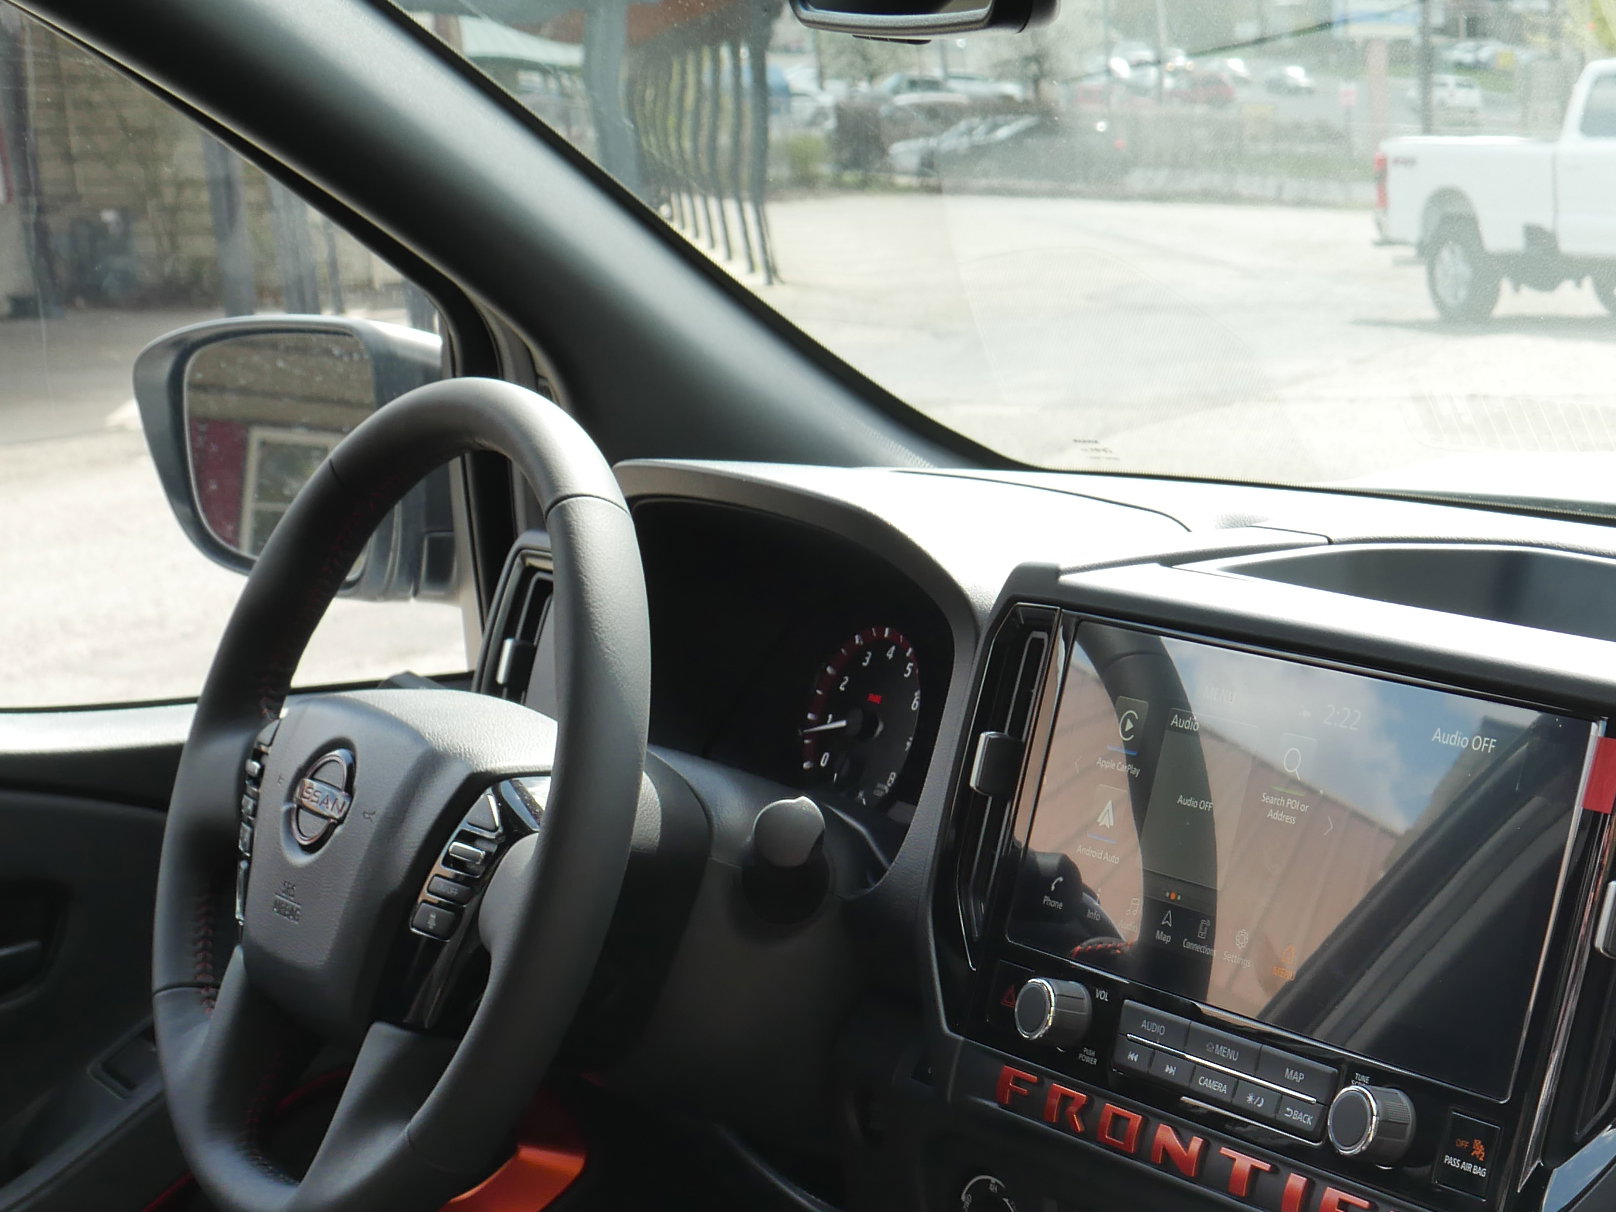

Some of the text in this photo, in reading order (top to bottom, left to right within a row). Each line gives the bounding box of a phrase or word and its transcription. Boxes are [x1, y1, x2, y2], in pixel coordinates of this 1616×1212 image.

[862, 652, 872, 667] 3
[887, 646, 895, 660] 4
[904, 663, 913, 678] 5
[840, 676, 848, 691] 2
[911, 695, 920, 711] 6
[1170, 713, 1200, 732] Audio
[1323, 704, 1362, 731] 2:22
[1432, 727, 1496, 754] Audio OFF
[820, 752, 829, 767] 0
[1096, 757, 1140, 777] Apple CarPlay
[887, 772, 896, 787] 8
[1177, 795, 1213, 811] Audio OFF
[1261, 792, 1284, 808] Search
[1300, 804, 1310, 814] or
[1266, 808, 1297, 825] Address
[1076, 845, 1120, 864] Android Auto
[1042, 896, 1063, 909] Phone
[1087, 909, 1100, 921] Info
[1155, 930, 1171, 944] Map
[1095, 988, 1110, 1002] VOL
[1141, 1019, 1166, 1036] AUDIO
[1215, 1044, 1240, 1061] MENU
[1284, 1067, 1305, 1082] MAP
[1198, 1076, 1227, 1094] CAMERA
[1293, 1110, 1314, 1126] BACK
[1444, 1155, 1487, 1178] PASS AIR BAG
